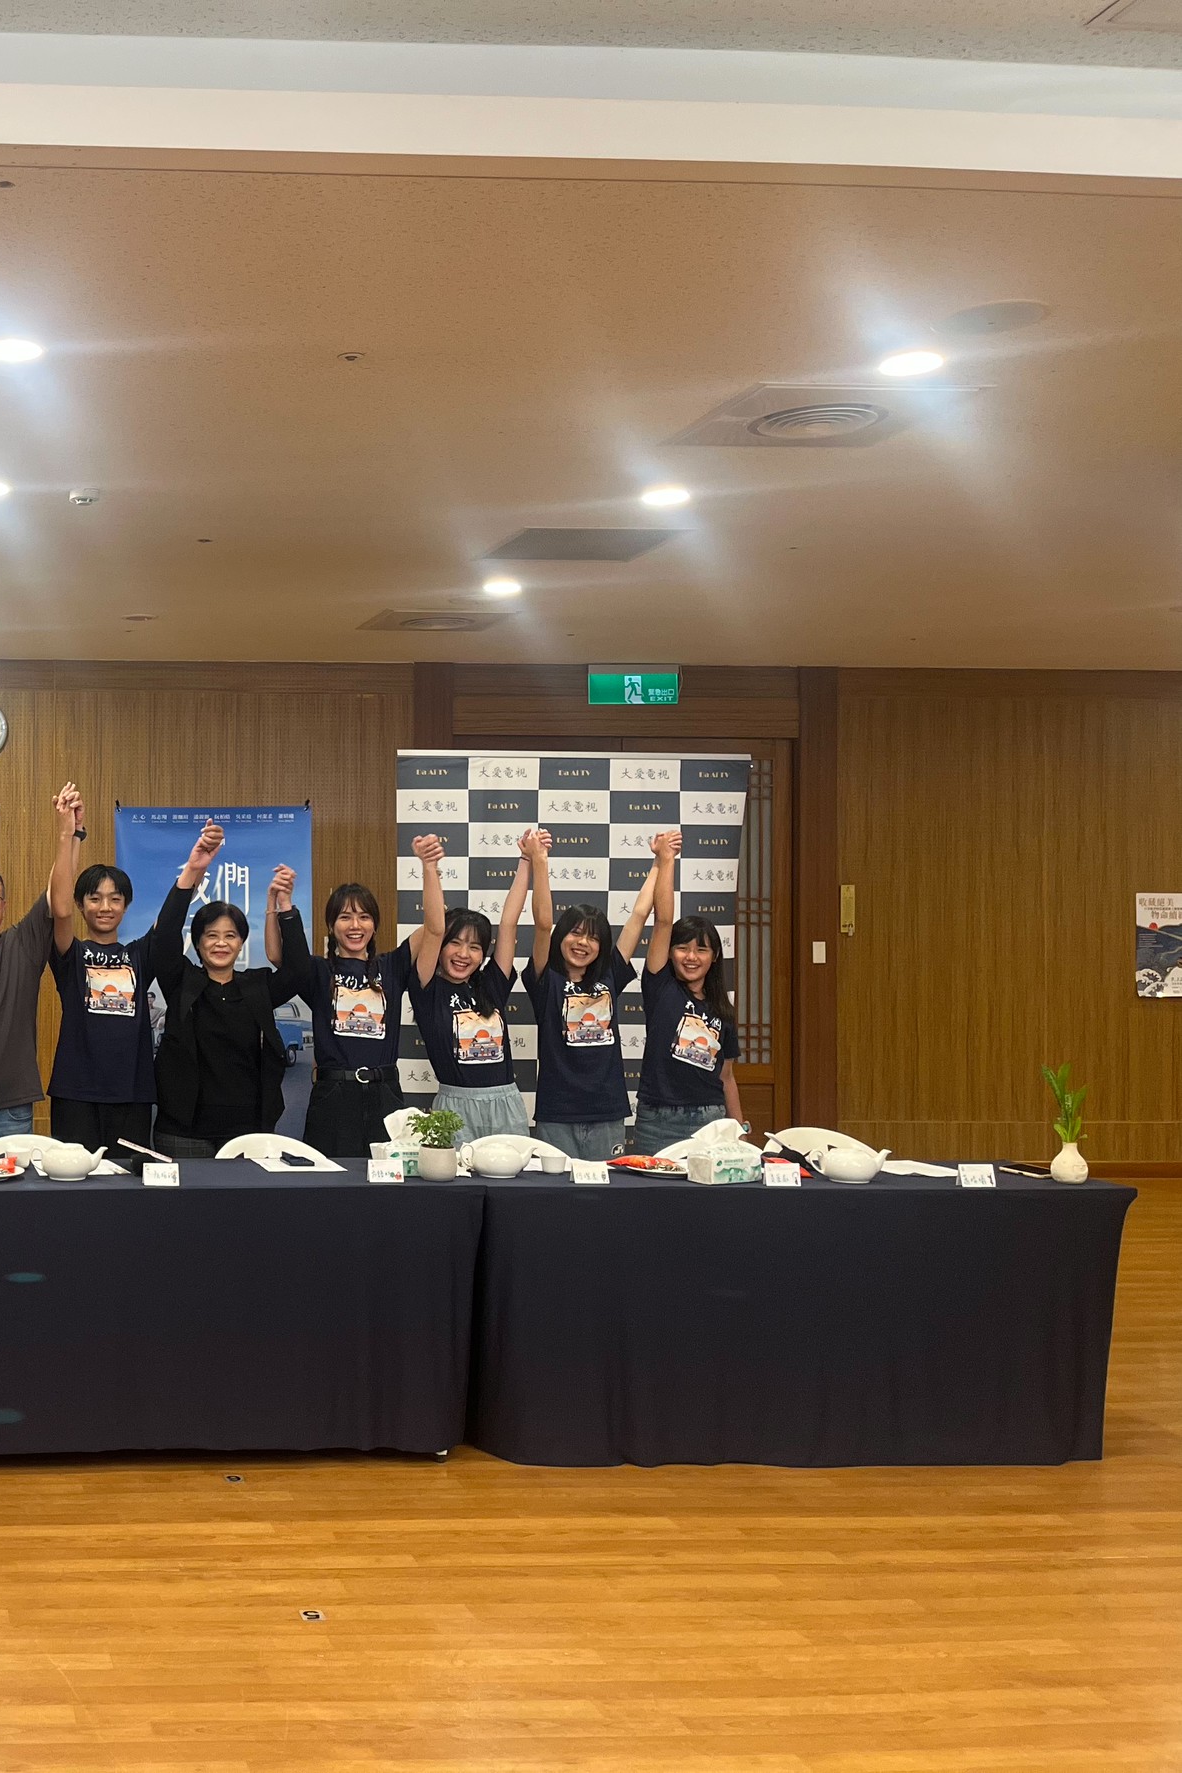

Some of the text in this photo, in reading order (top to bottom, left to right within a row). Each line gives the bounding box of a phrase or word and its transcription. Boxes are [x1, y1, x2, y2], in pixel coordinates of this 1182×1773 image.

[648, 688, 675, 696] 緊急出口
[478, 766, 528, 779] 大愛電視
[620, 767, 670, 780] 大愛電視
[407, 800, 458, 812] 大愛電視
[547, 800, 598, 813] 大愛電視
[691, 802, 739, 814] 大愛電視
[692, 869, 735, 881] 大愛電視
